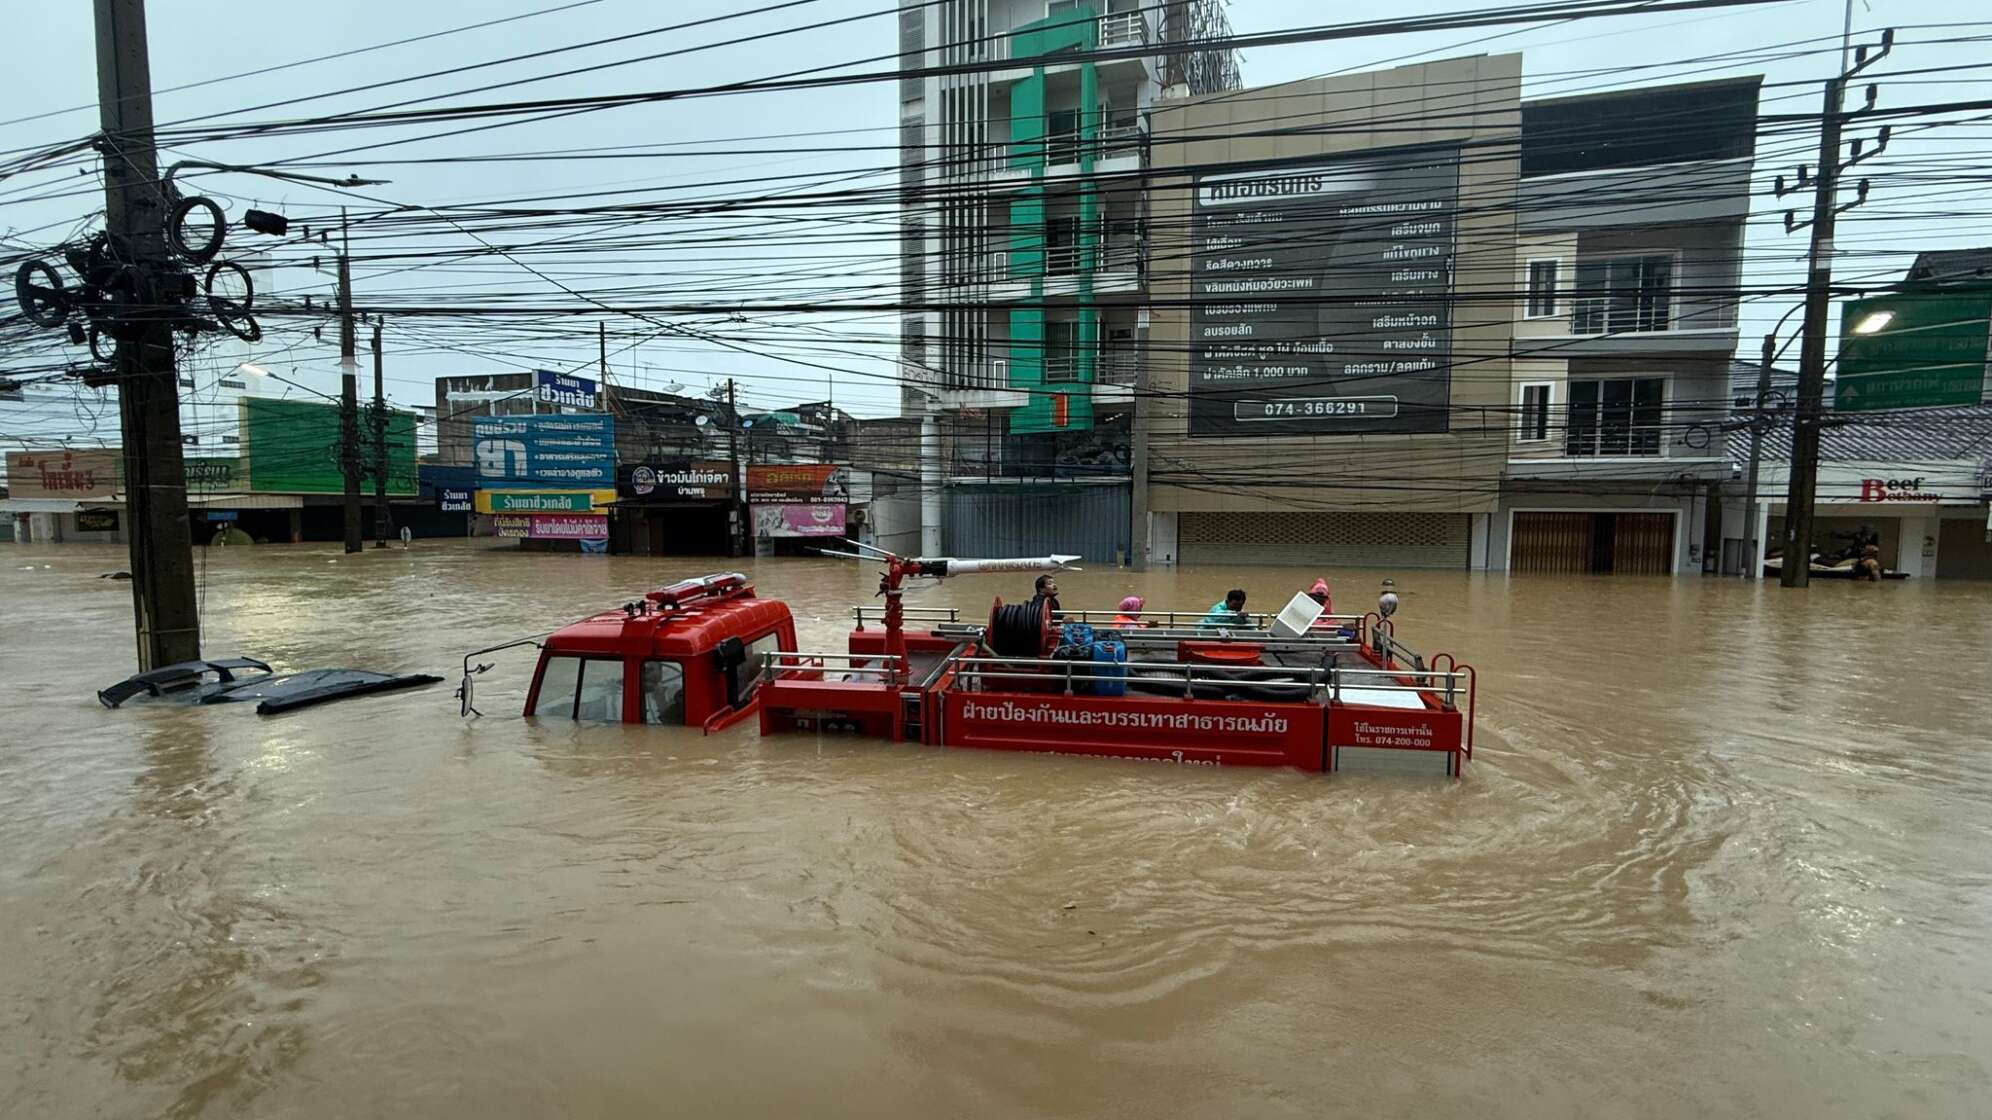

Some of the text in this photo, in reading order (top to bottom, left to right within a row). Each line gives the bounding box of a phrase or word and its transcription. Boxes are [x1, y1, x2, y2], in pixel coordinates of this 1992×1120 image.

[1391, 222, 1440, 236] เสริมจมก
[1373, 313, 1437, 328] เสริมหน้าอก
[1204, 322, 1252, 337] ลบรอยสัก
[1253, 366, 1284, 379] 1,000
[1287, 366, 1308, 376] บาท
[555, 374, 580, 389] ร้านยา
[1264, 402, 1366, 416] 074-366291
[476, 439, 528, 478] ยา
[443, 489, 468, 500] ร้านยา
[963, 701, 1288, 733] ฝ่ายป้องกันและบรรเทาสาธารณภัย
[1354, 722, 1433, 736] ใช้ในราชการเท่านั้น
[1375, 736, 1431, 747] 074-200-000
